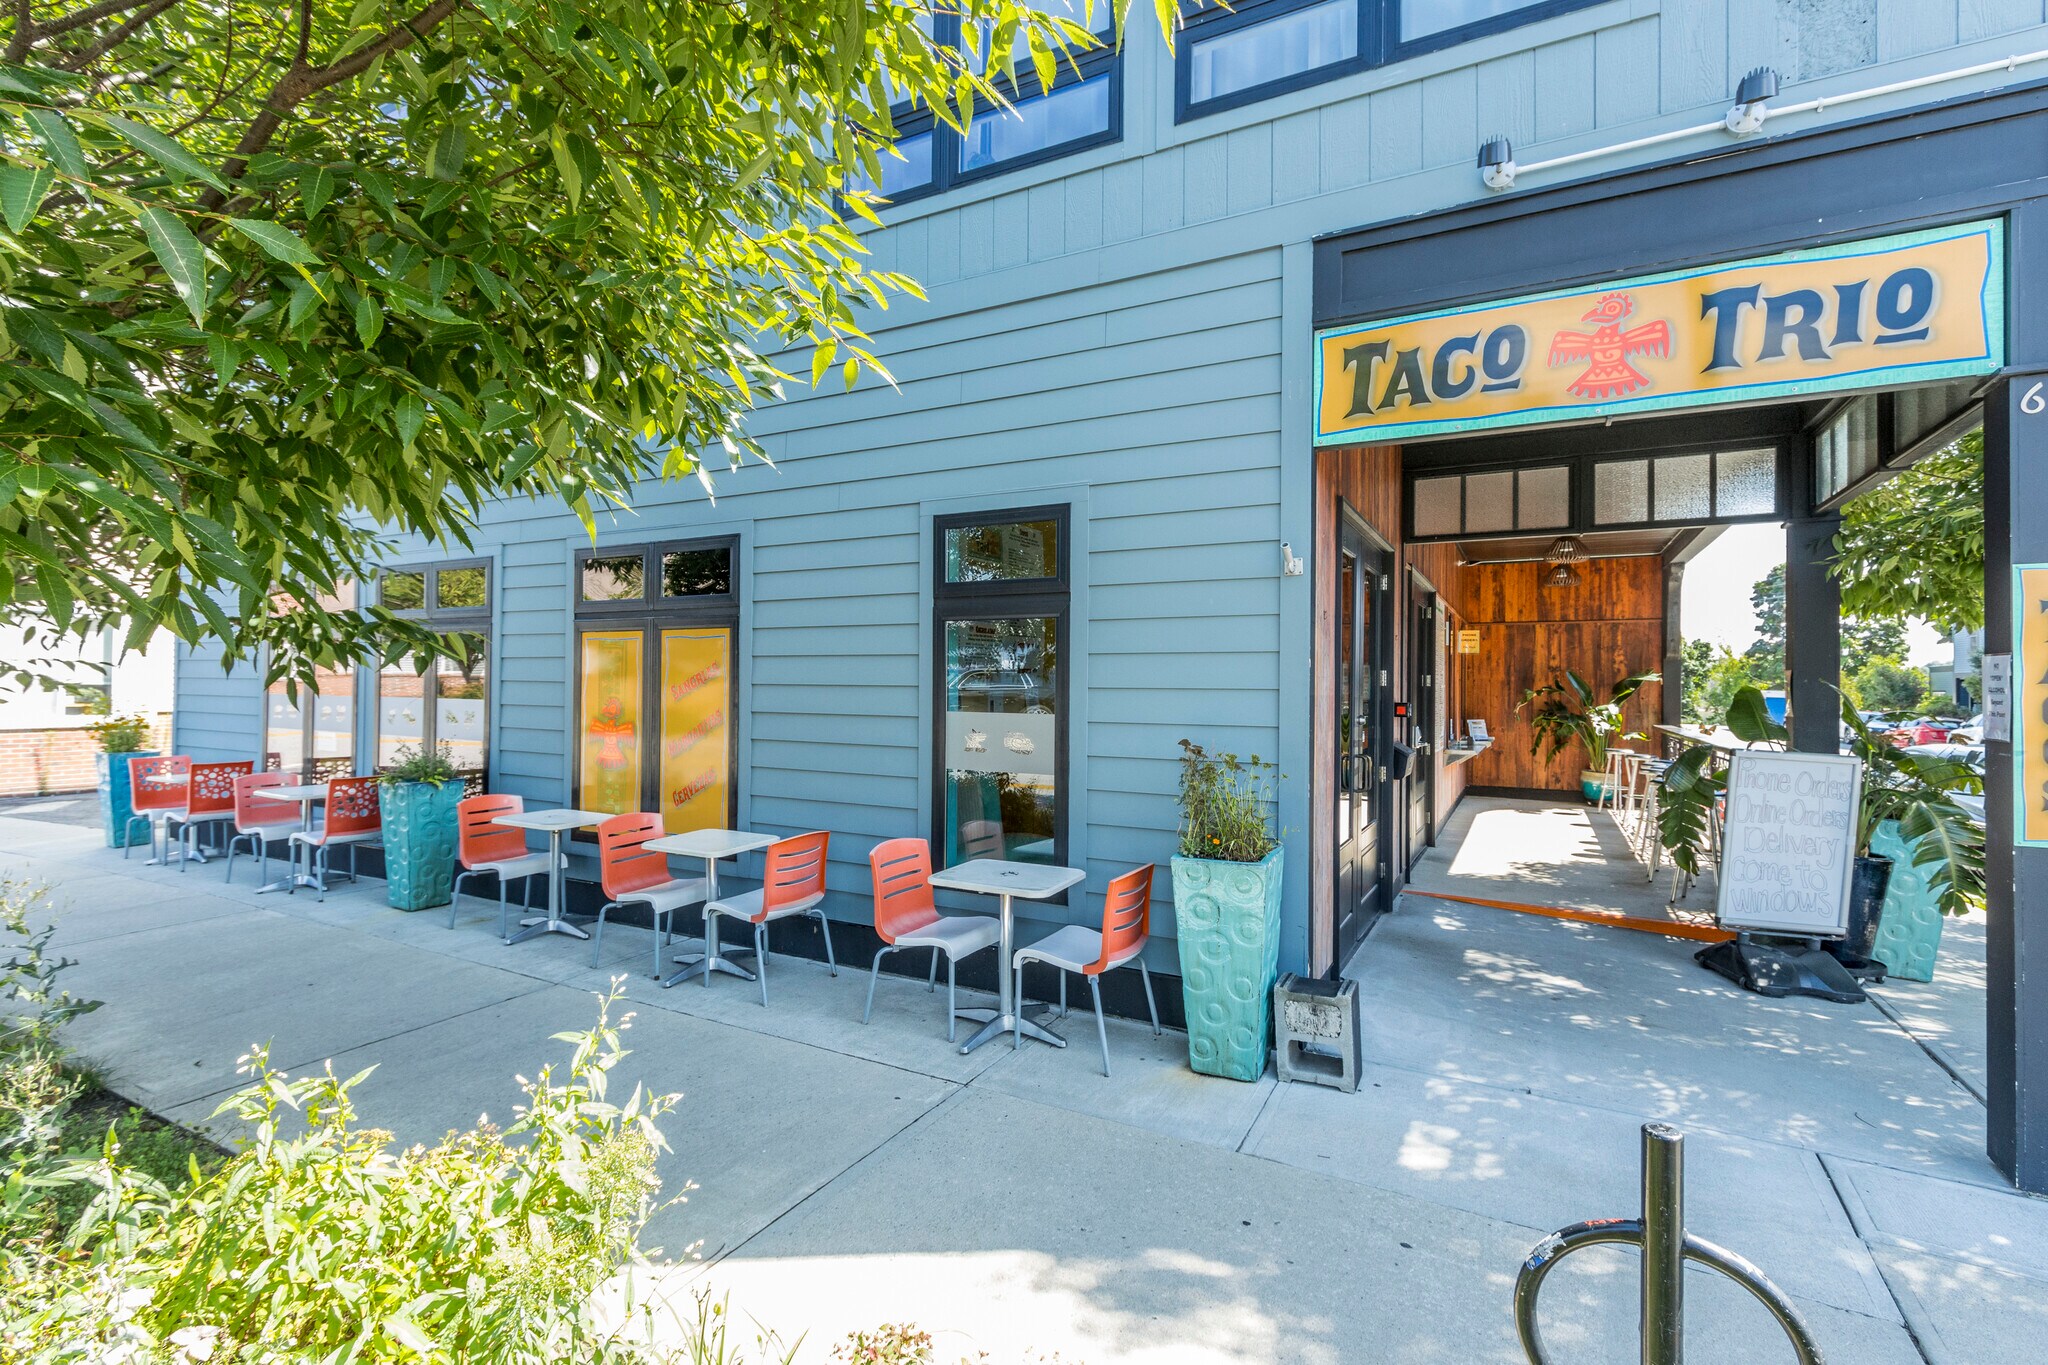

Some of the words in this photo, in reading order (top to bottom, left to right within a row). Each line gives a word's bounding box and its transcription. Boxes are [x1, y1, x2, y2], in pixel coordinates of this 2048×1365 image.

[1342, 324, 1526, 420] TACO
[1699, 266, 1934, 375] TRIO
[2020, 381, 2046, 414] 6
[1737, 759, 1791, 793] Phone
[1795, 767, 1851, 802] Orders
[1735, 793, 1787, 825] Online
[1789, 798, 1849, 830] Orders
[1744, 825, 1840, 870] Delivery
[1795, 860, 1828, 891] to
